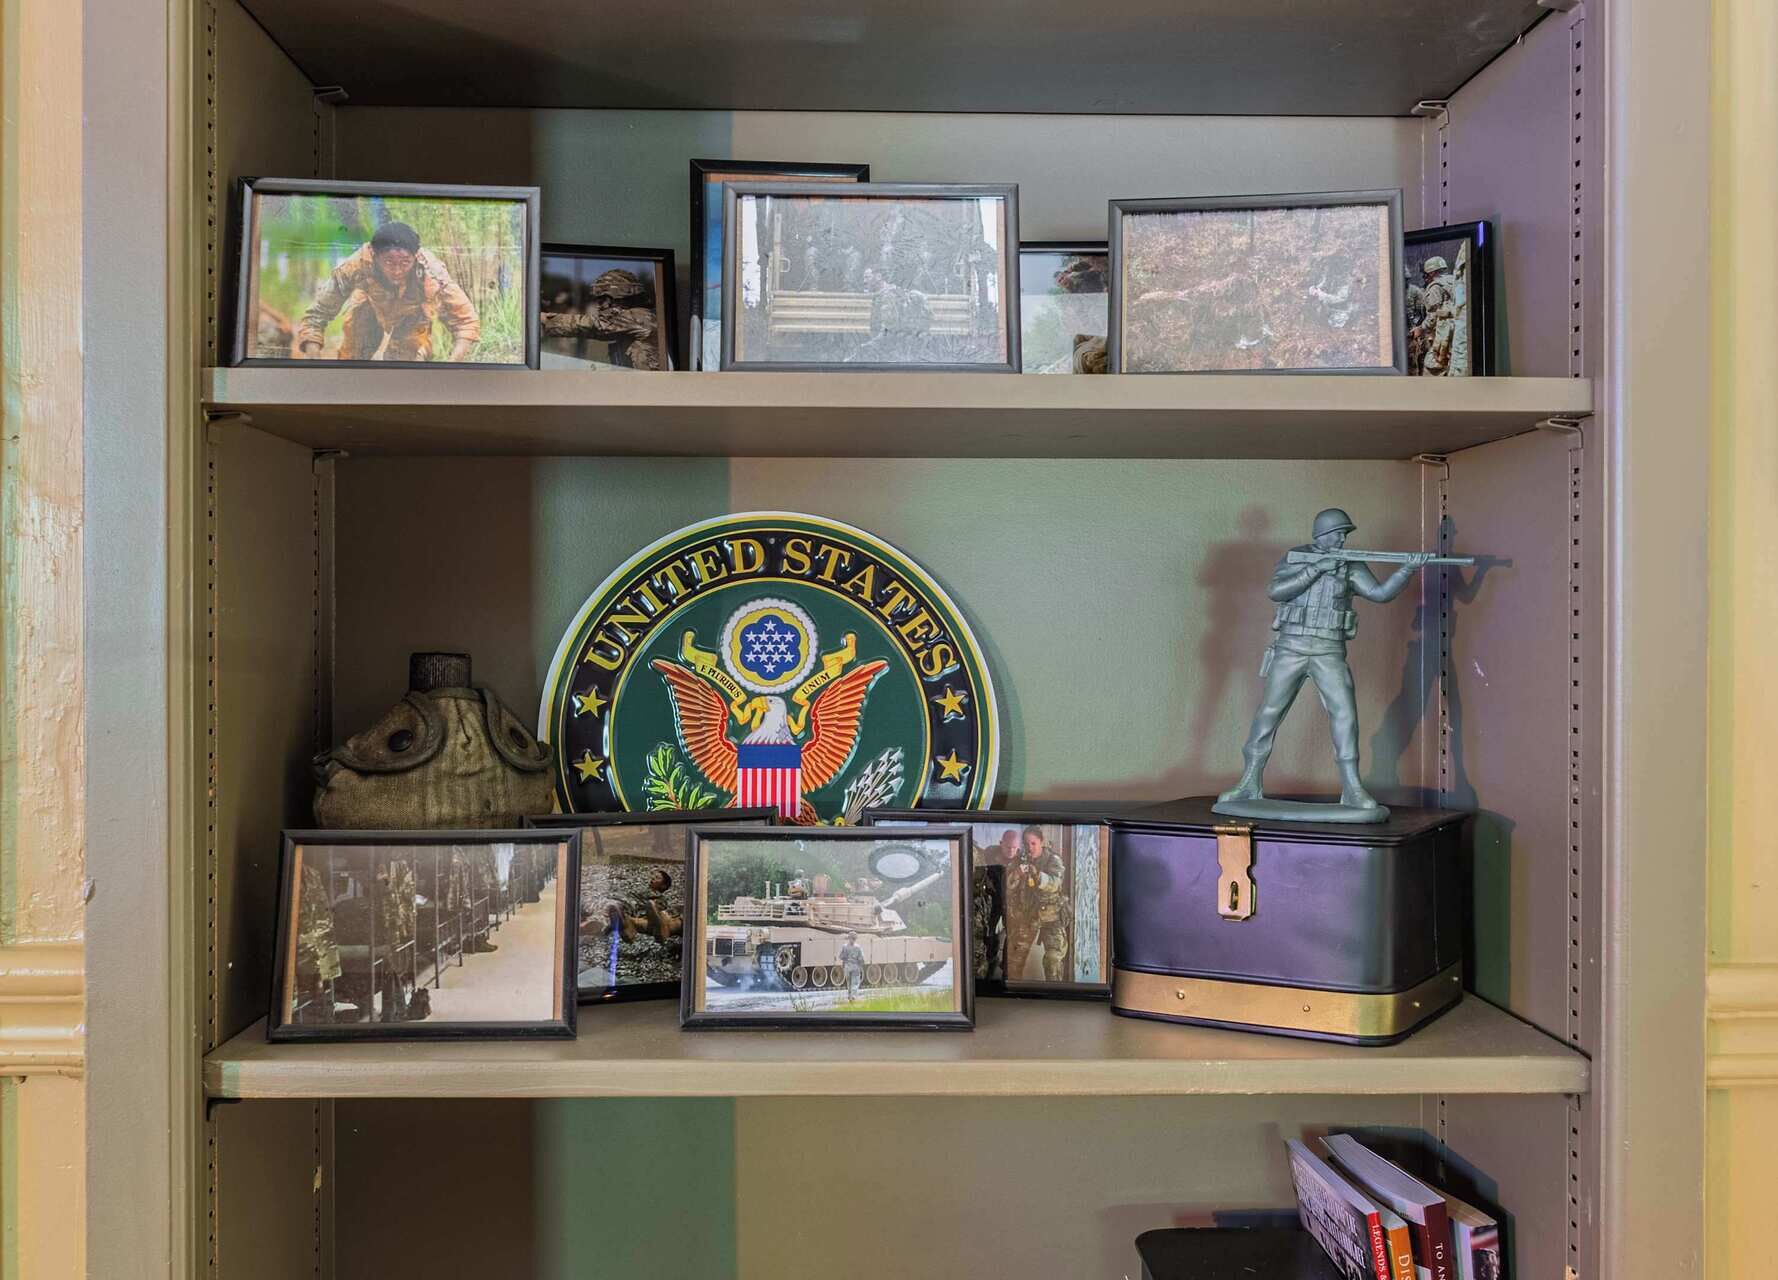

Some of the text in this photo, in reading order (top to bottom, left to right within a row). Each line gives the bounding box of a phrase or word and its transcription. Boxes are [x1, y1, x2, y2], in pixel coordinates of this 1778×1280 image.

[584, 538, 957, 677] UNITED STATES
[707, 666, 742, 698] PLURIBUS
[802, 672, 831, 696] UNUM
[1373, 1223, 1385, 1272] LEGENDS
[1379, 1273, 1387, 1280] &
[1434, 1243, 1444, 1260] TO
